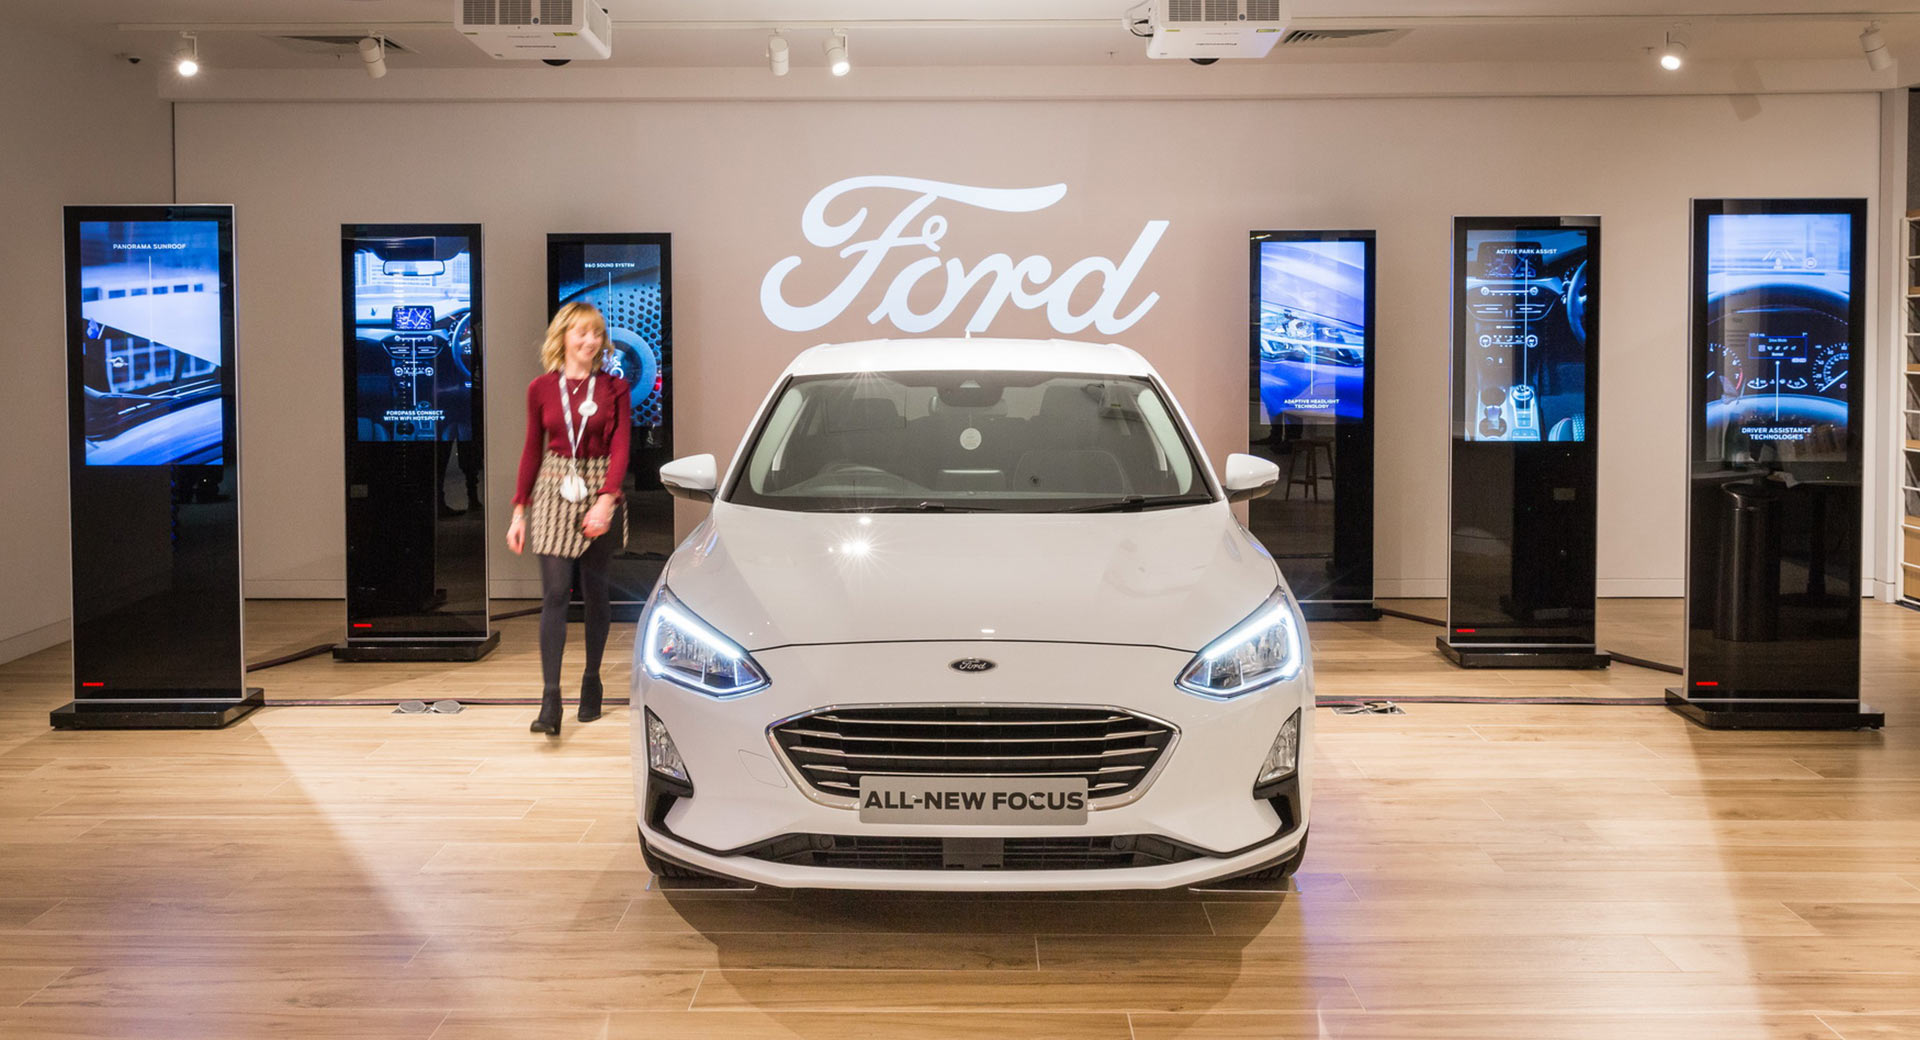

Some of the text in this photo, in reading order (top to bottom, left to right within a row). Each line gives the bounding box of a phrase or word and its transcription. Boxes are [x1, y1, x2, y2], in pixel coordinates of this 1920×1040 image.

[760, 175, 1170, 335] Ford
[864, 790, 1084, 811] ALL-NEW FOCUS
